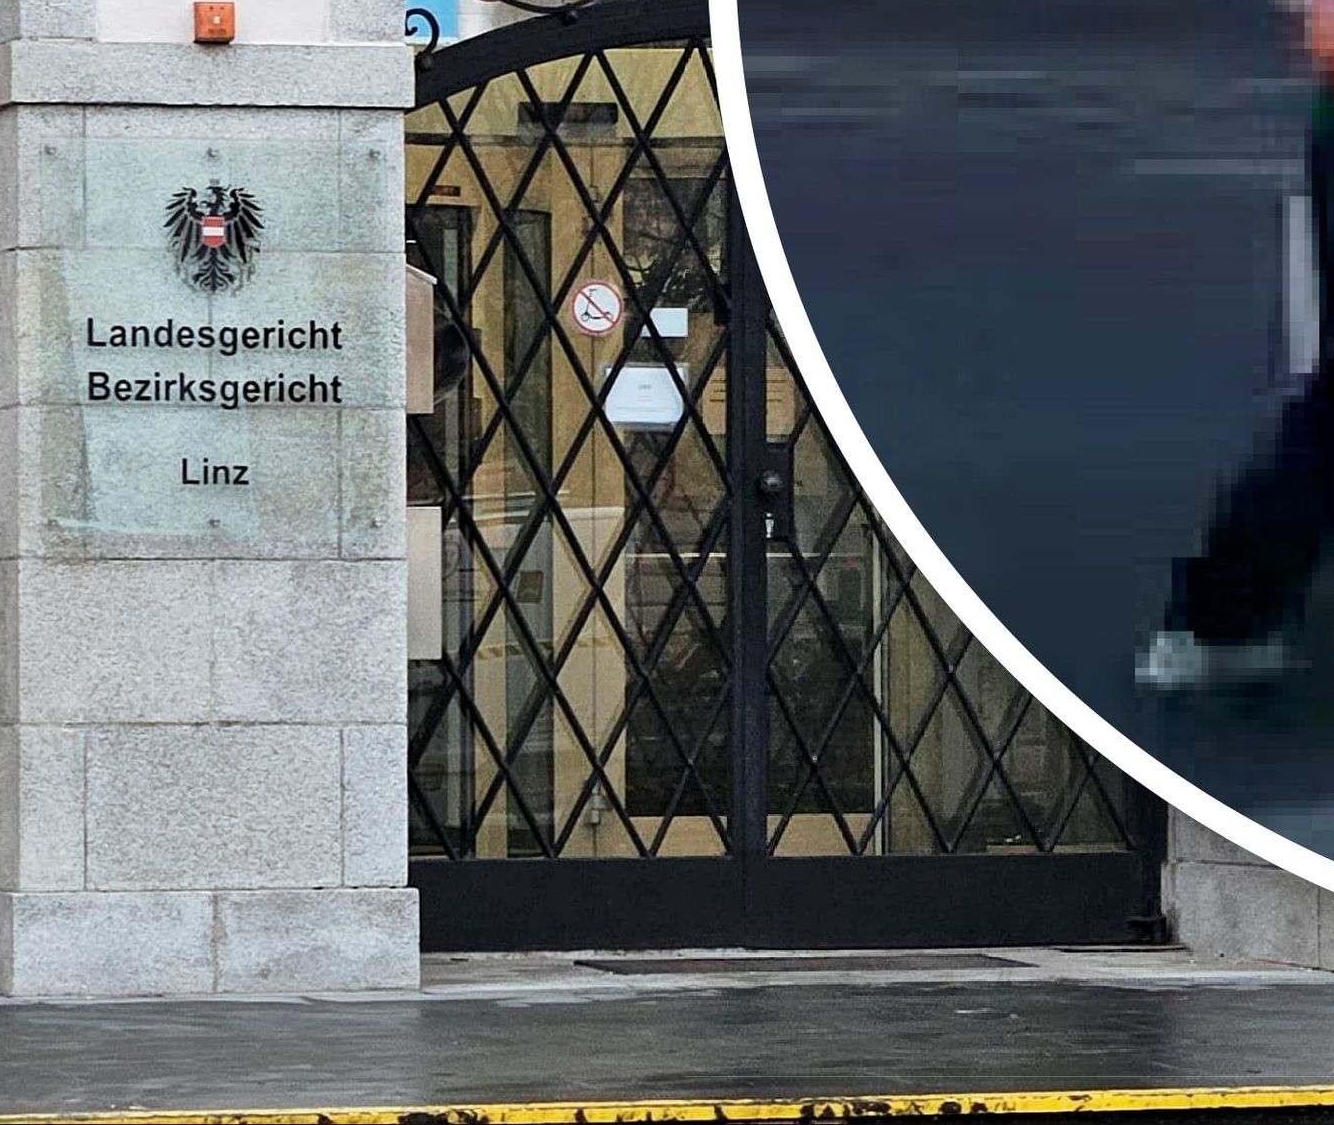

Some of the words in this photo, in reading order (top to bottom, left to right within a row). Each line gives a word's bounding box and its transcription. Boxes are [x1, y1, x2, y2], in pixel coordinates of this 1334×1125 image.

[86, 317, 344, 357] Landesgericht
[87, 371, 344, 411] Bezirksgericht
[181, 457, 250, 486] Linz
